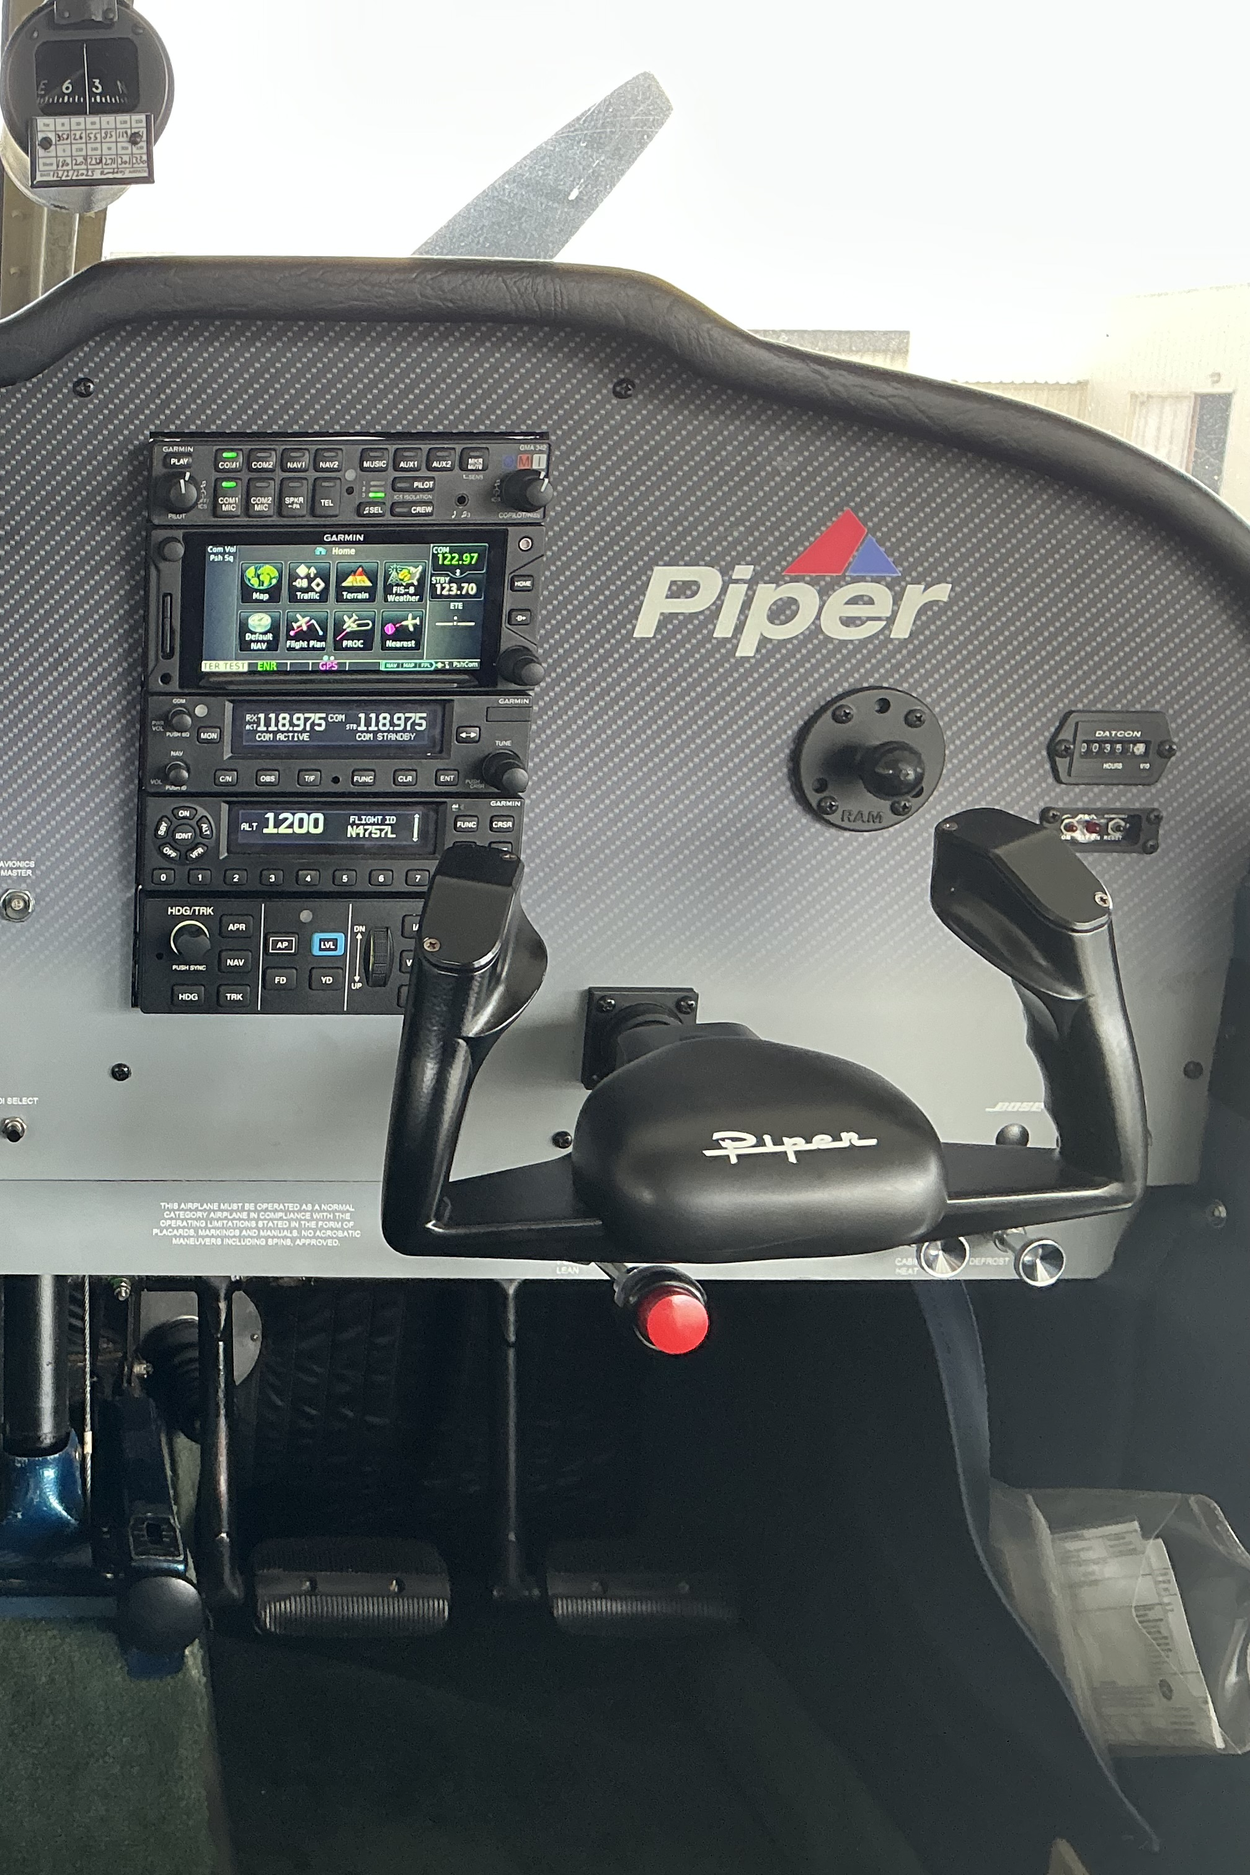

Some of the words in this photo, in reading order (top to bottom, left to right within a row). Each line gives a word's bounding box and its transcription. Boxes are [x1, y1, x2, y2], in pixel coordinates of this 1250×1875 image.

[61, 79, 73, 94] 6
[92, 79, 103, 94] 3
[363, 460, 387, 468] MUSIC
[323, 534, 364, 542] GARMIN
[332, 547, 355, 555] Home
[437, 553, 478, 565] 122.97
[435, 583, 477, 595] 123.70
[252, 592, 269, 601] Map
[296, 592, 320, 600] Traffic
[387, 594, 419, 602] Weather
[632, 565, 951, 657] Piper
[251, 642, 267, 650] NAV
[286, 640, 308, 648] Flight
[309, 640, 325, 648] Plan
[342, 640, 363, 648] PROC
[386, 640, 416, 648] Nearest
[257, 662, 277, 670] ENR
[319, 662, 338, 670] GPS
[257, 713, 326, 731] 118.975
[328, 714, 345, 722] COM
[357, 713, 427, 731] 118.975
[256, 733, 273, 741] COM
[276, 733, 310, 741] ACTIVE
[356, 733, 373, 741] COM
[377, 733, 416, 741] STANDBY
[1096, 730, 1141, 738] DATCON
[349, 816, 382, 824] FLIGHT
[384, 816, 396, 824] ID
[841, 810, 884, 824] RAM
[241, 822, 258, 831] ALT
[262, 812, 324, 834] 1200
[347, 825, 396, 838] N4757L
[0, 869, 32, 877] MASTER
[168, 906, 214, 916] HDG/TRK
[228, 923, 246, 931] APR
[276, 940, 288, 949] AP
[320, 940, 335, 949] LVL
[227, 958, 244, 966] NAV
[275, 976, 287, 984] FD
[321, 976, 333, 984] YD
[179, 992, 198, 1001] HDG
[226, 993, 243, 1001] TRK
[6, 1097, 39, 1105] SELECT
[985, 1102, 1044, 1112] BOSE
[702, 1129, 878, 1165] Piper
[163, 1211, 208, 1219] CATEGORY
[259, 1229, 299, 1237] MANUALS.
[267, 1238, 294, 1246] SPINS,
